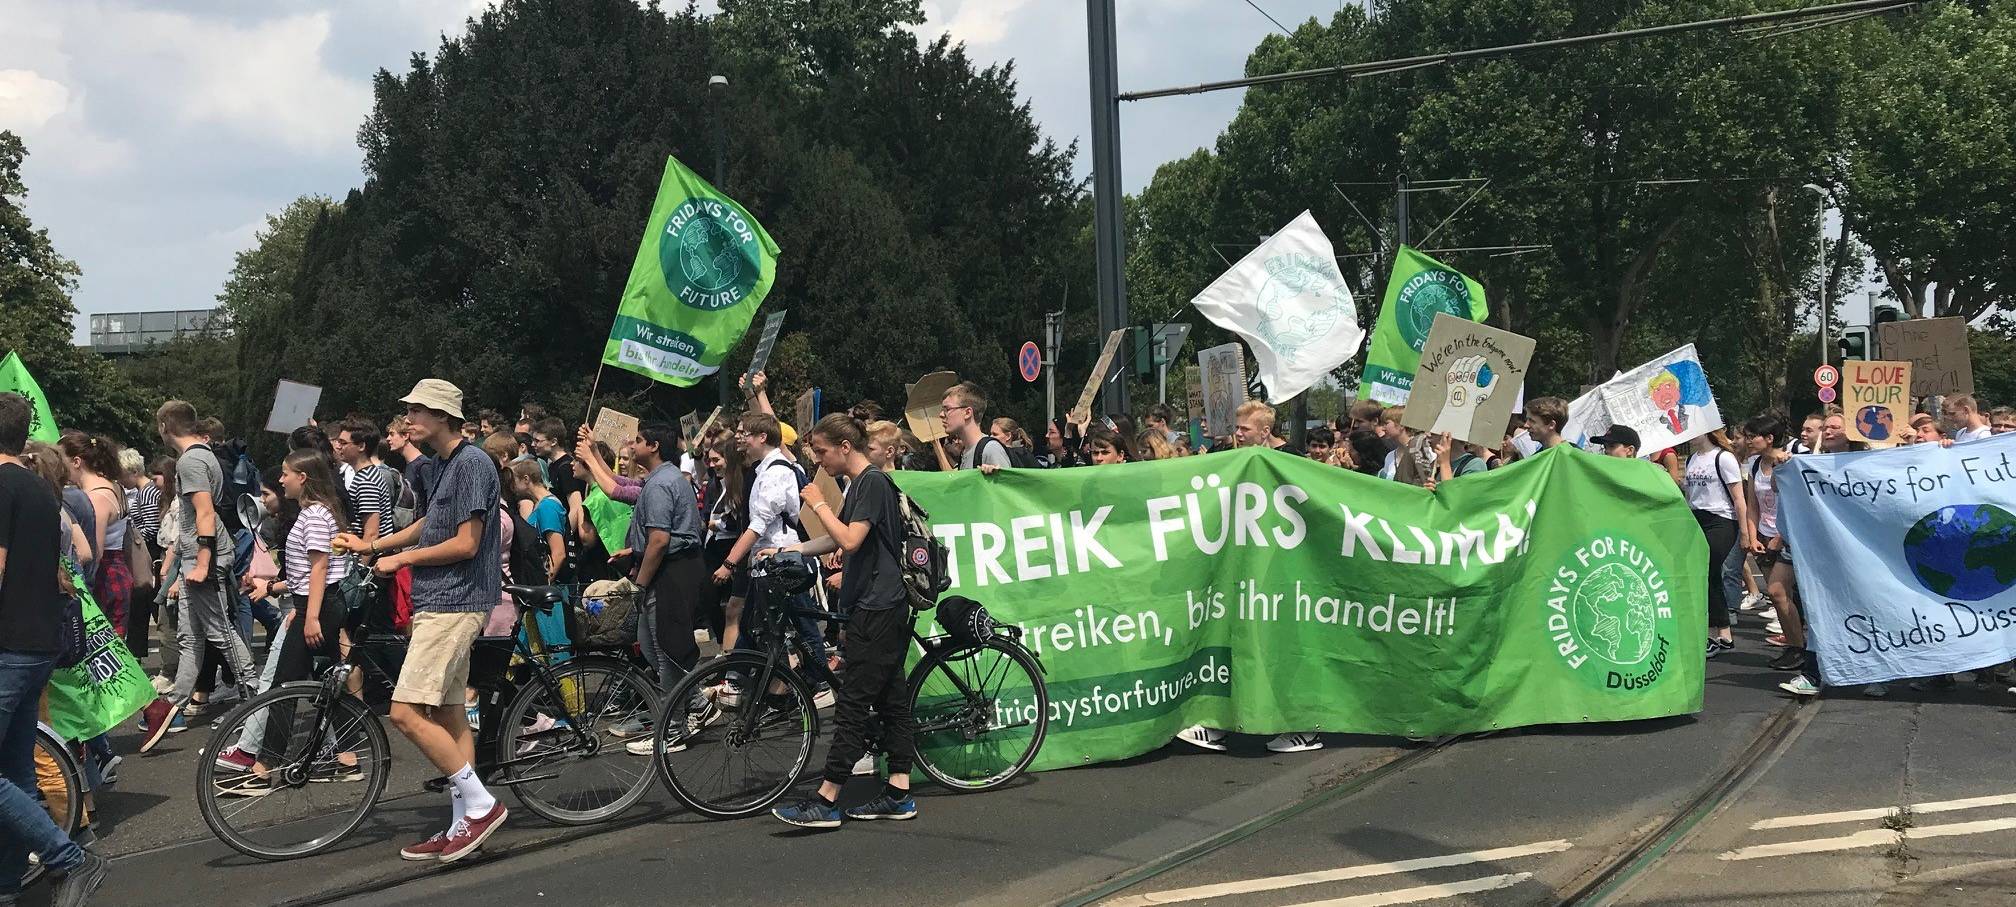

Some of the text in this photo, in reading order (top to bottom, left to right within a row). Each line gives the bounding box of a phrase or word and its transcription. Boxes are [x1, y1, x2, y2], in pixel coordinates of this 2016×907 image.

[666, 201, 753, 245] FRIDAYS FOR
[680, 285, 741, 308] FUTURE
[1400, 270, 1468, 303] FRIDAYS FOR
[636, 323, 653, 341] Wir
[1421, 343, 1454, 373] We're
[1454, 338, 1464, 350] in
[1466, 334, 1480, 347] the
[1381, 370, 1396, 382] Wir
[1820, 371, 1833, 382] 60
[1851, 386, 1902, 404] YOUR
[1855, 366, 1905, 385] LOVE
[1802, 452, 2016, 503] Fridays for Fut
[932, 473, 1537, 589] TREIK FÜRS KLIMA!
[1186, 585, 1227, 630] bis
[1239, 579, 1283, 621] ihr
[1295, 580, 1456, 636] handelt!
[1547, 536, 1672, 670] FRIDAYS FOR FUTURE
[1845, 602, 2016, 654] Studis Düss
[1606, 633, 1669, 691] Düsseldorf
